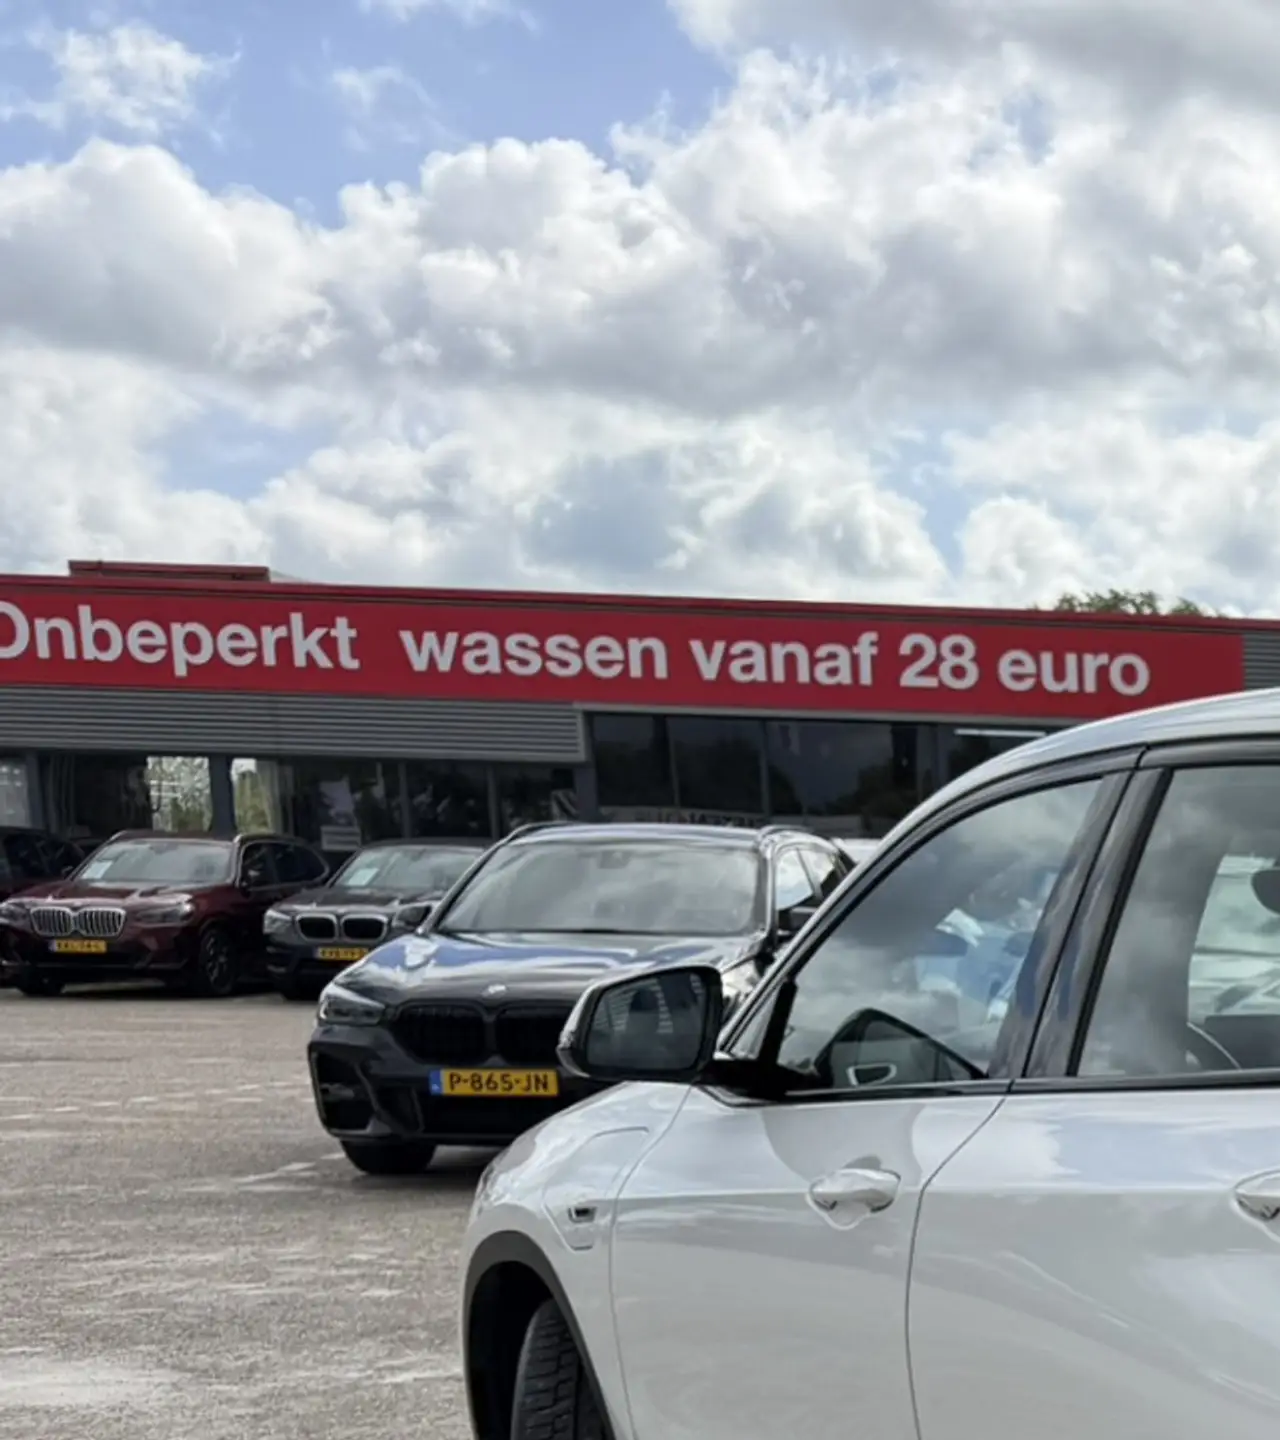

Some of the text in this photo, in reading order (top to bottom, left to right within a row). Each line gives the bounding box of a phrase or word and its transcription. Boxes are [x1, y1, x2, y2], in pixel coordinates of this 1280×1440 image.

[399, 630, 668, 679] wassen
[689, 632, 878, 686] vanaf
[899, 633, 979, 689] 28
[998, 650, 1149, 695] euro
[449, 1072, 549, 1092] P-865-JN
